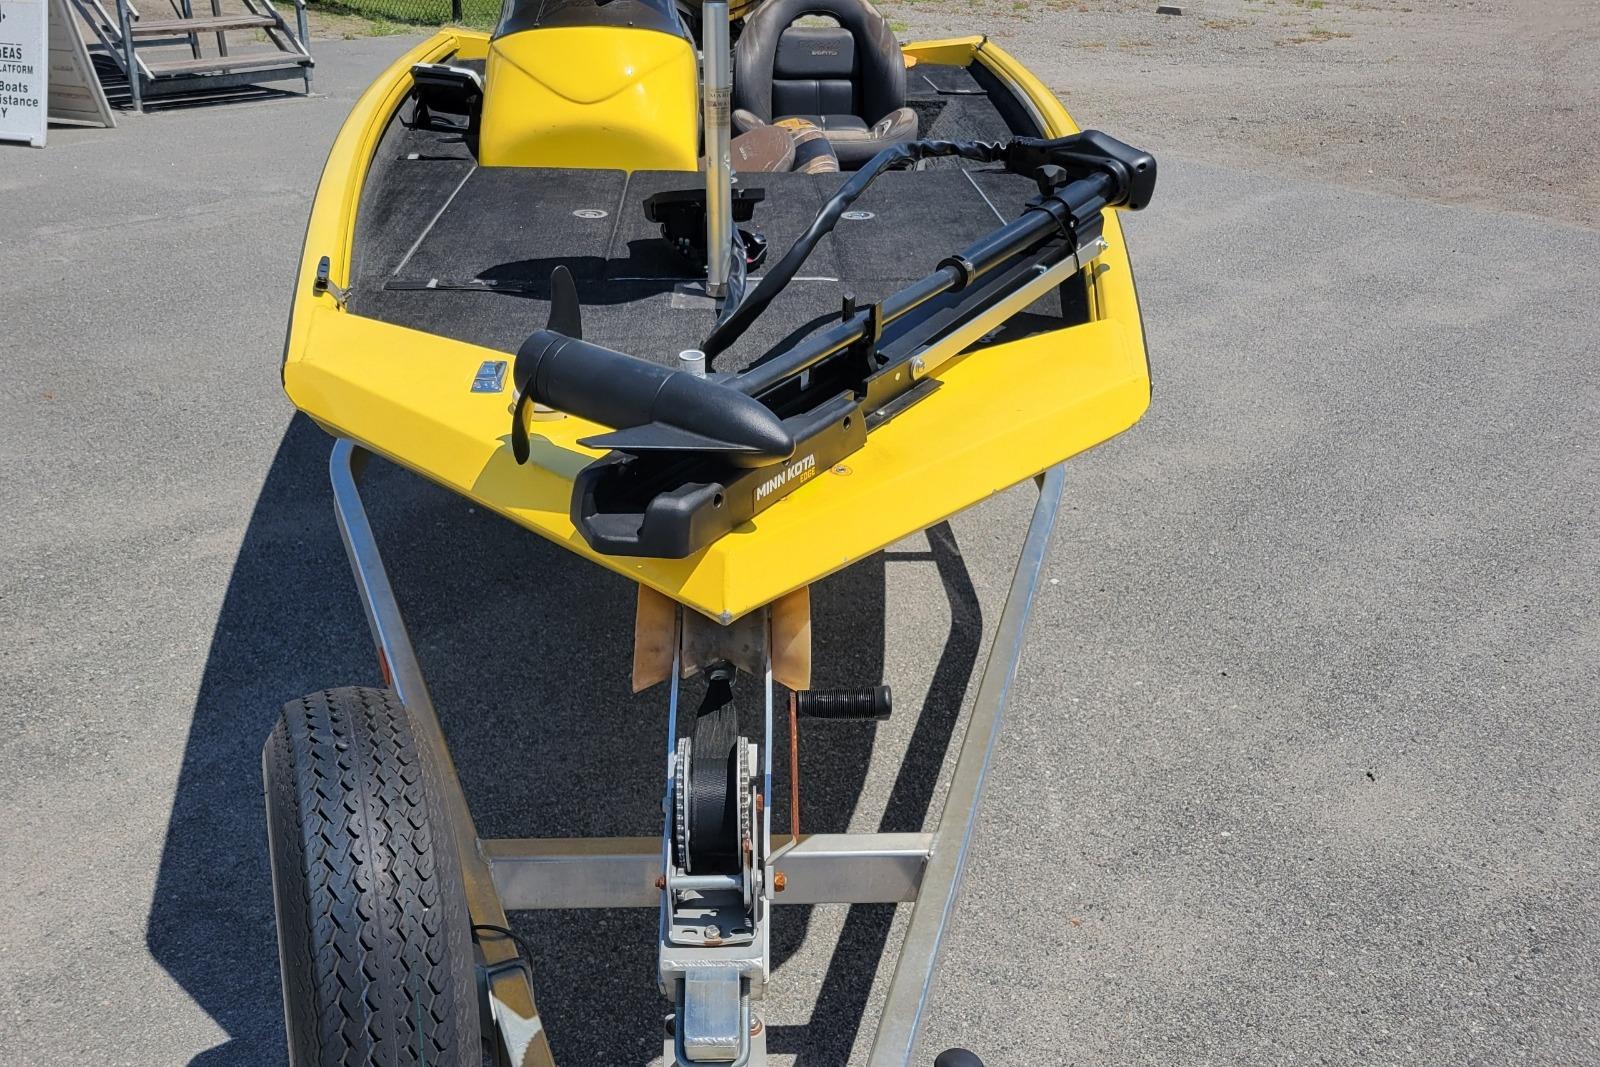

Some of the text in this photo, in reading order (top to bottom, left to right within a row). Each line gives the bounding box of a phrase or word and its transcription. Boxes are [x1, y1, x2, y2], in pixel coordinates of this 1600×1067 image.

[0, 47, 22, 60] EAS
[0, 80, 28, 92] Boats
[1, 107, 8, 118] Y
[756, 453, 815, 501] MINN KOTA
[800, 466, 816, 482] EDGE
